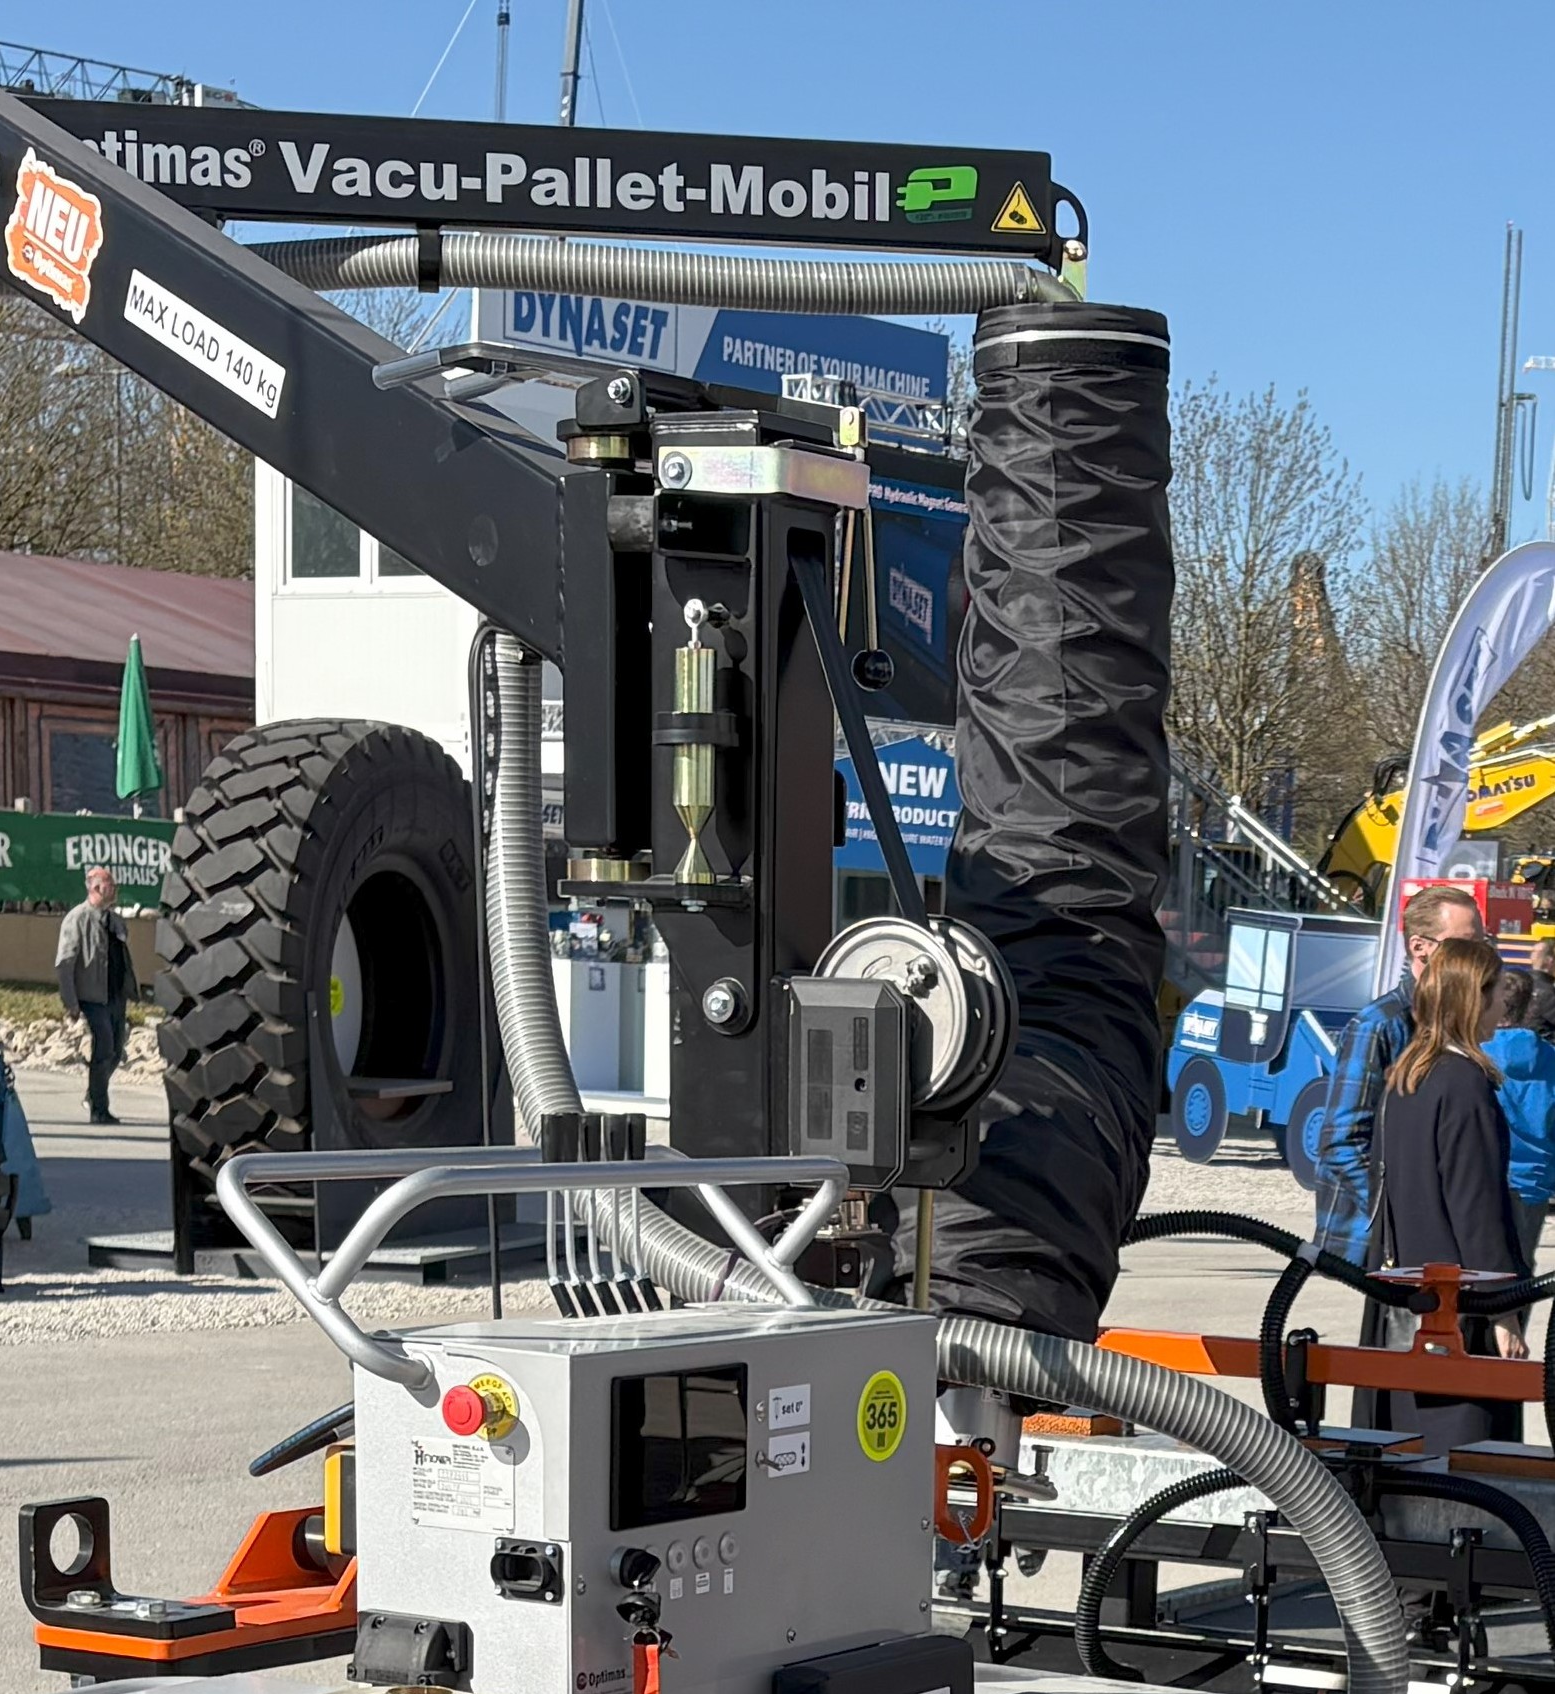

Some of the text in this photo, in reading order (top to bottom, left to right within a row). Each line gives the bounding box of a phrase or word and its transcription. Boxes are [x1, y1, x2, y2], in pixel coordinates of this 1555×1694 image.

[279, 141, 890, 222] Vacu-Pallet-Mobil
[25, 179, 90, 264] NEU
[513, 291, 669, 361] DYNASET
[129, 285, 278, 409] MAX LOAD 140 kg
[722, 335, 795, 374] PARTNER
[797, 351, 819, 375] OF
[863, 364, 932, 398] MACHINE
[878, 762, 948, 798] NEW
[1467, 774, 1535, 802] OMATSU
[892, 805, 958, 828] RODUCT
[66, 832, 173, 874] ERDINGER
[781, 1403, 795, 1415] set
[865, 1401, 898, 1431] 365
[588, 1668, 627, 1689] Optimas
